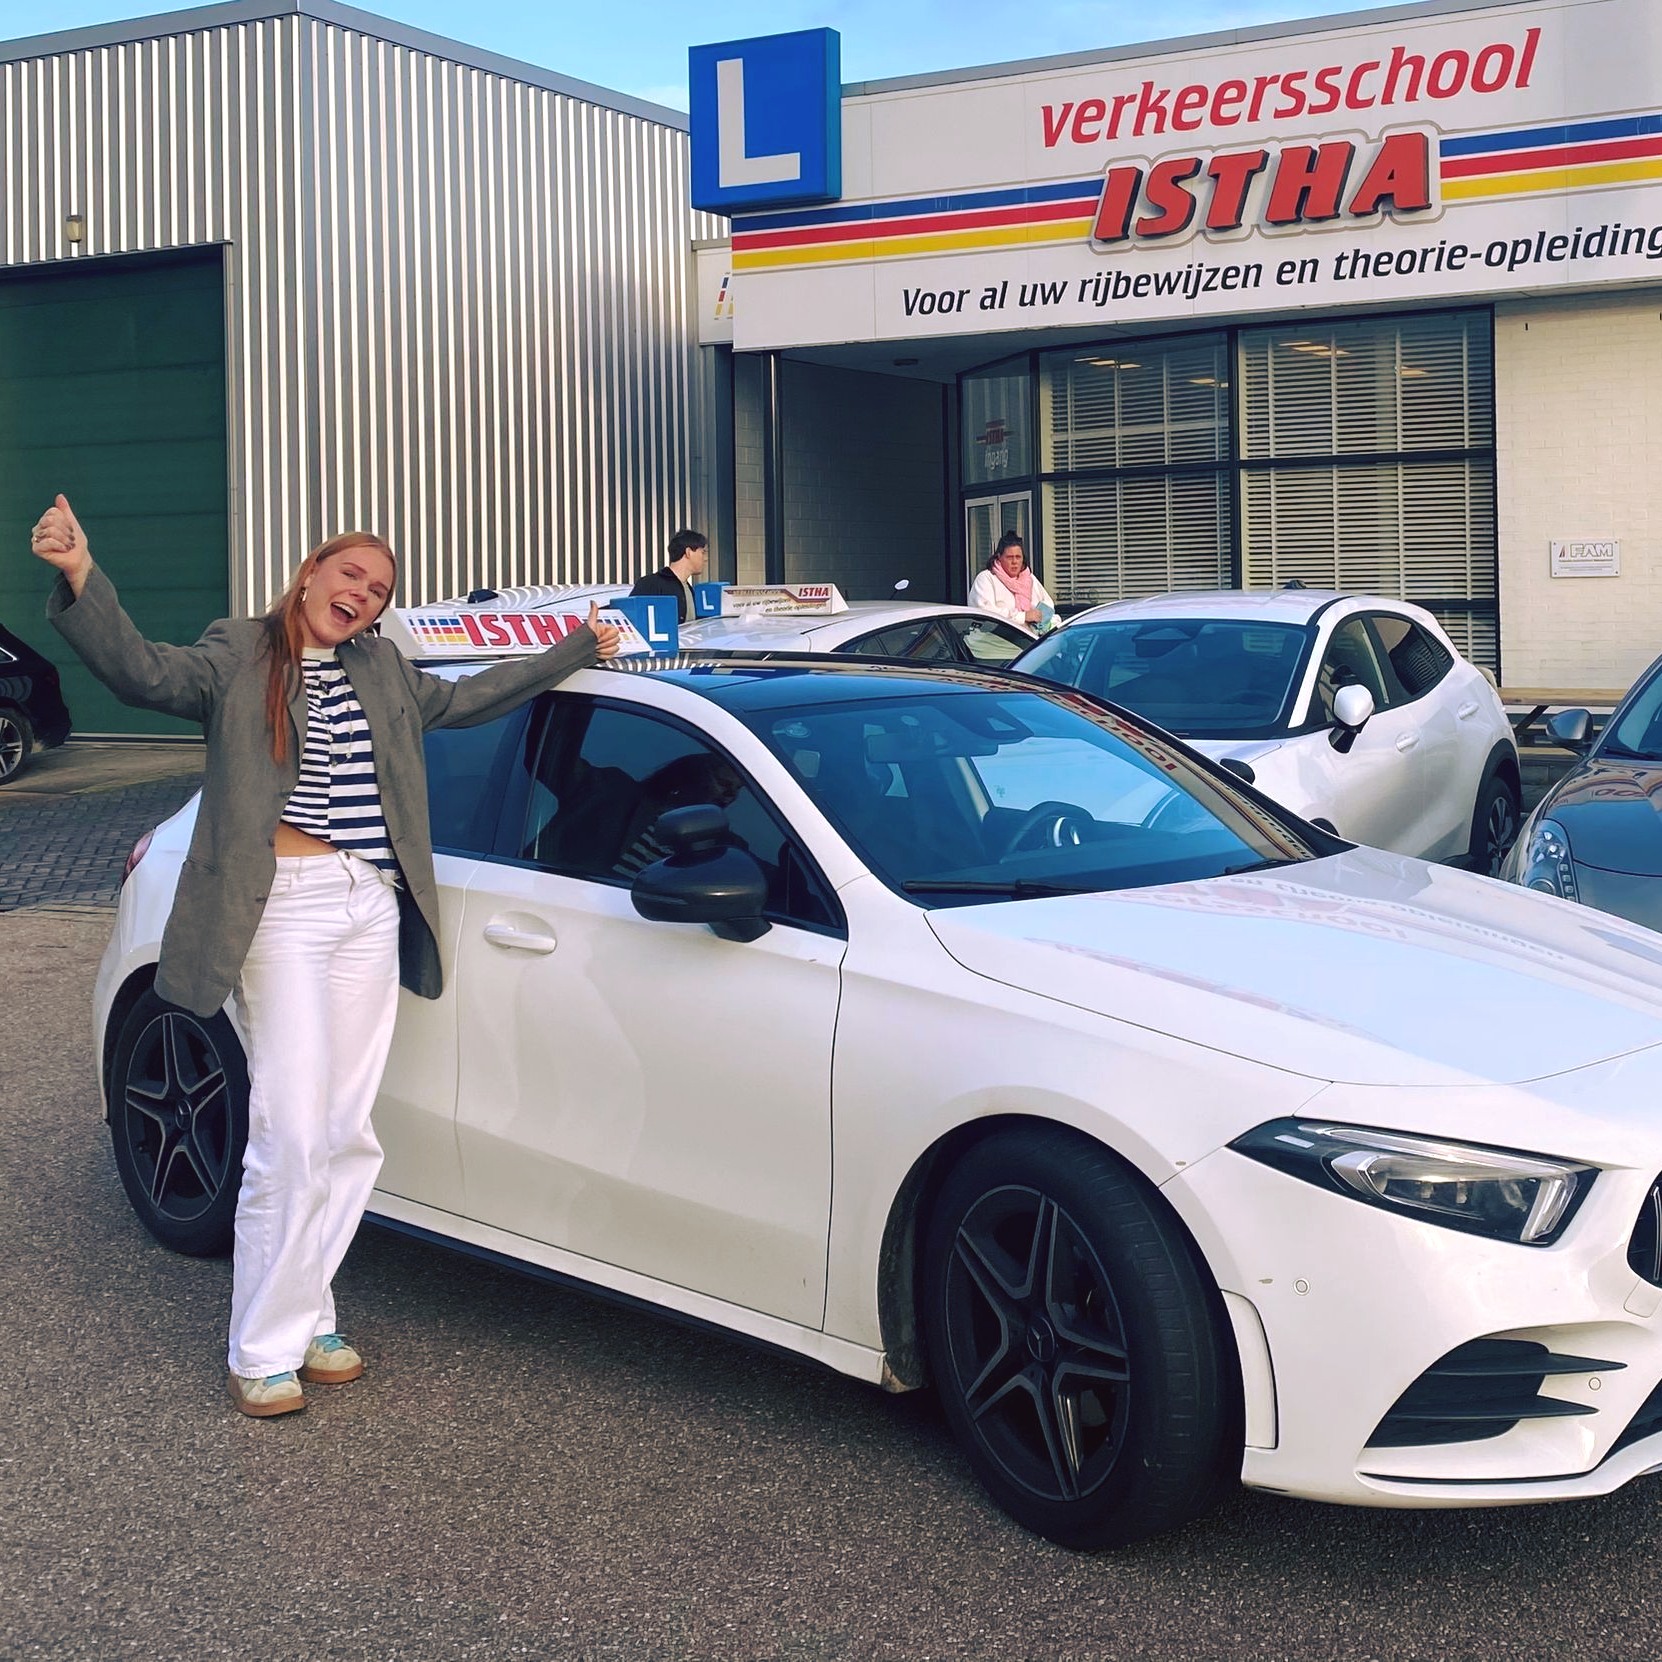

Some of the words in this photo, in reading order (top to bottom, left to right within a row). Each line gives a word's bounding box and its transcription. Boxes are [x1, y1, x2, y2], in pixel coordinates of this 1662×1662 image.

[1042, 28, 1541, 148] verkeersschool
[717, 58, 801, 188] L
[1094, 132, 1432, 242] ISTHA
[903, 287, 971, 316] Voor
[979, 280, 1009, 311] al
[1018, 280, 1069, 307] uw
[1077, 261, 1263, 307] rijbewijzen
[1276, 258, 1320, 286] en
[1570, 543, 1613, 557] FAM
[702, 590, 715, 610] L
[798, 587, 829, 597] ISTHA
[647, 605, 669, 642] L
